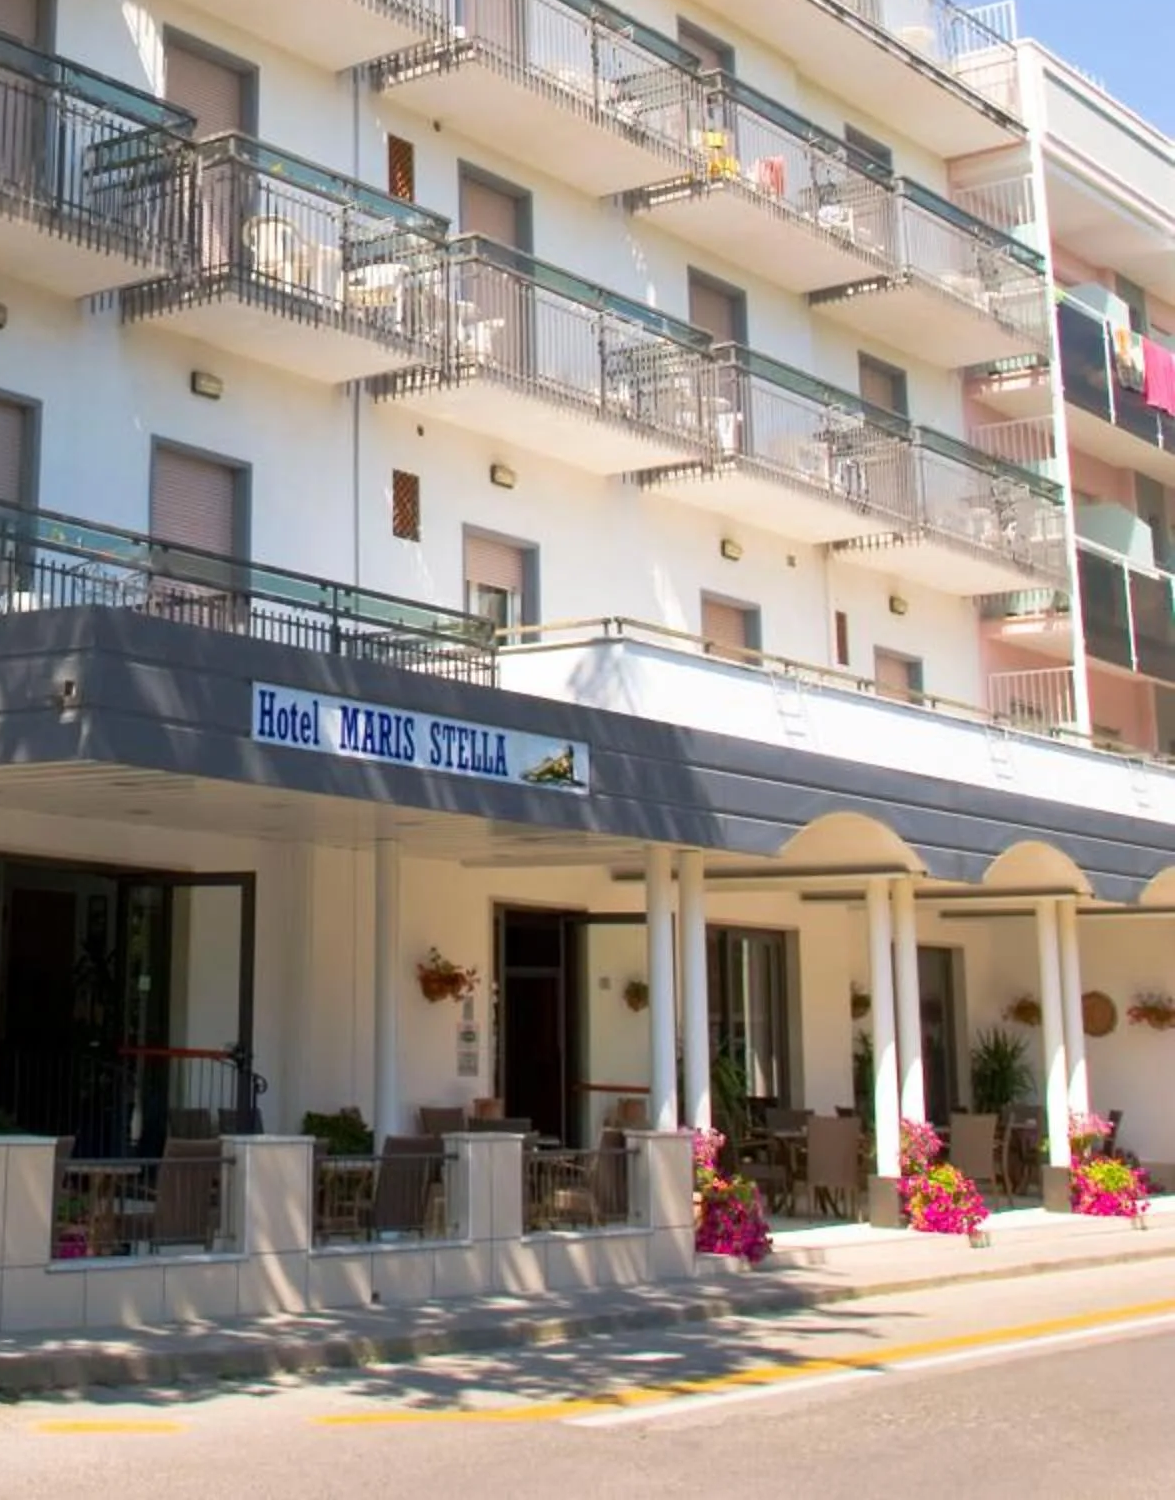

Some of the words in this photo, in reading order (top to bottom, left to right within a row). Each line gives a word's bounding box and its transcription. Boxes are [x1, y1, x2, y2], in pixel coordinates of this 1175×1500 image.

[258, 690, 320, 745] Hotel
[340, 706, 415, 761] MARIS
[429, 722, 508, 776] STELLA
